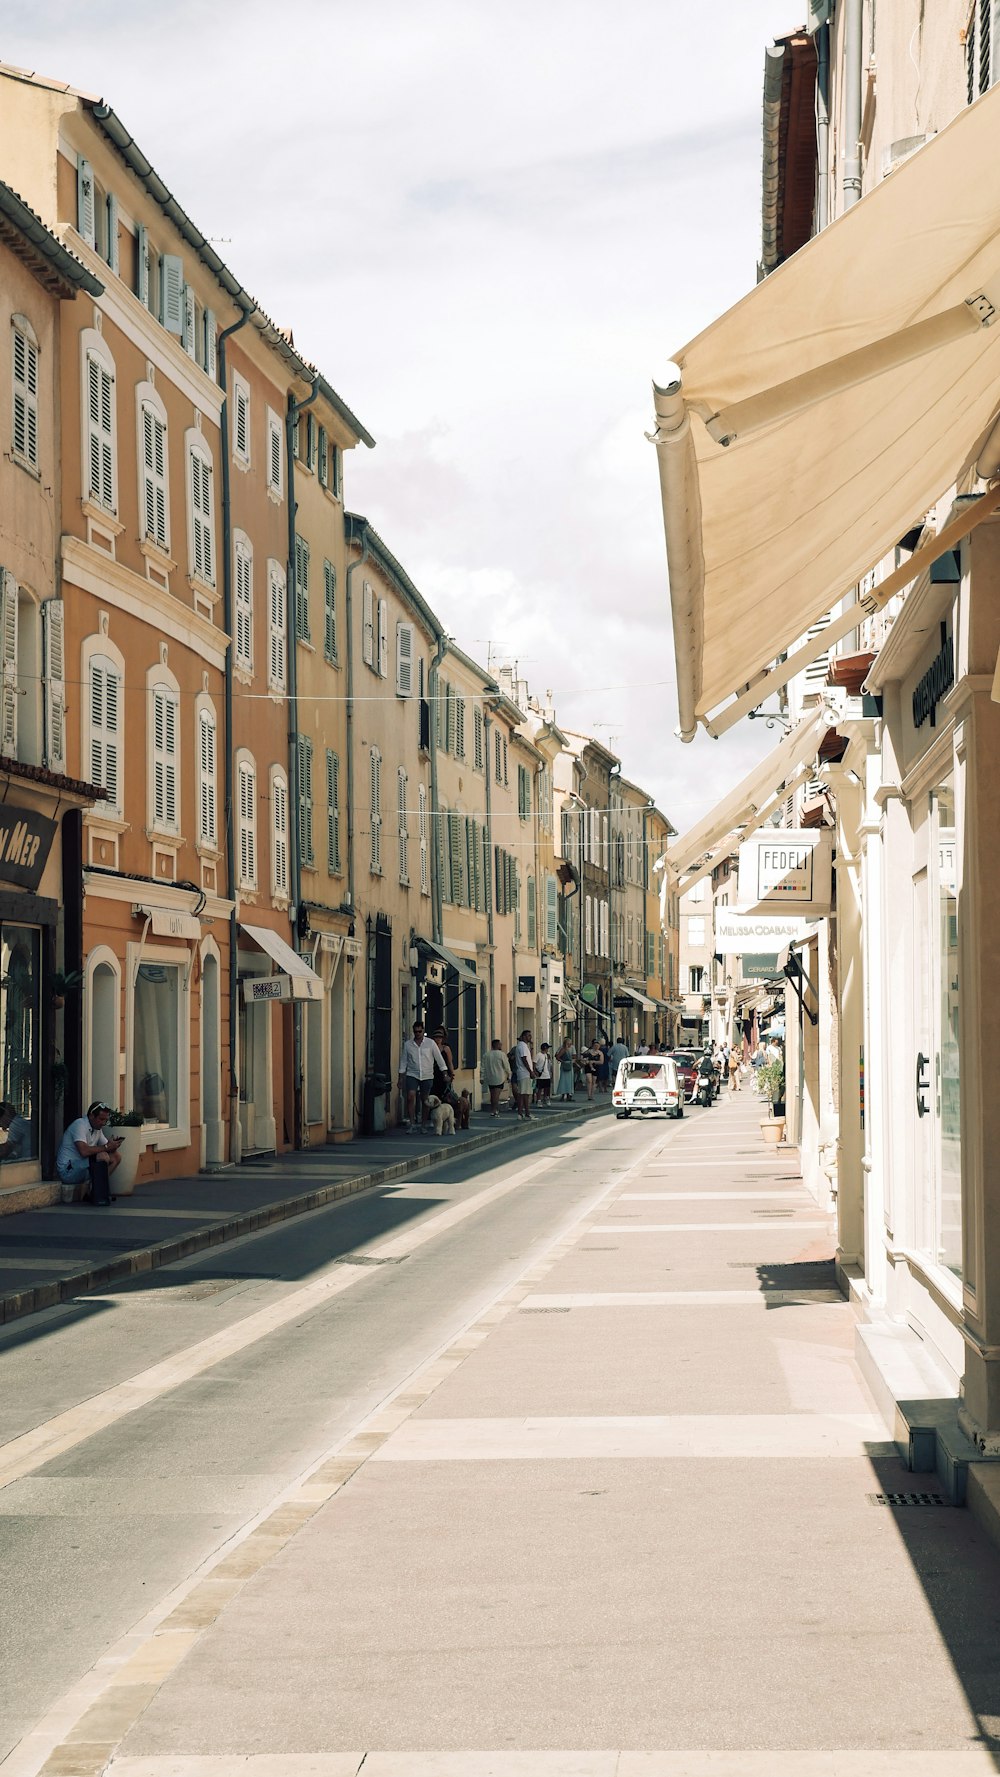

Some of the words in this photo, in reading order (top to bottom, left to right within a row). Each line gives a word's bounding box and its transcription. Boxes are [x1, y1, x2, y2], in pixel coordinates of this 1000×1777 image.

[764, 851, 807, 870] FEDELI
[719, 926, 754, 936] MELISSA
[755, 925, 799, 936] ODABASH
[747, 965, 775, 973] GERARD
